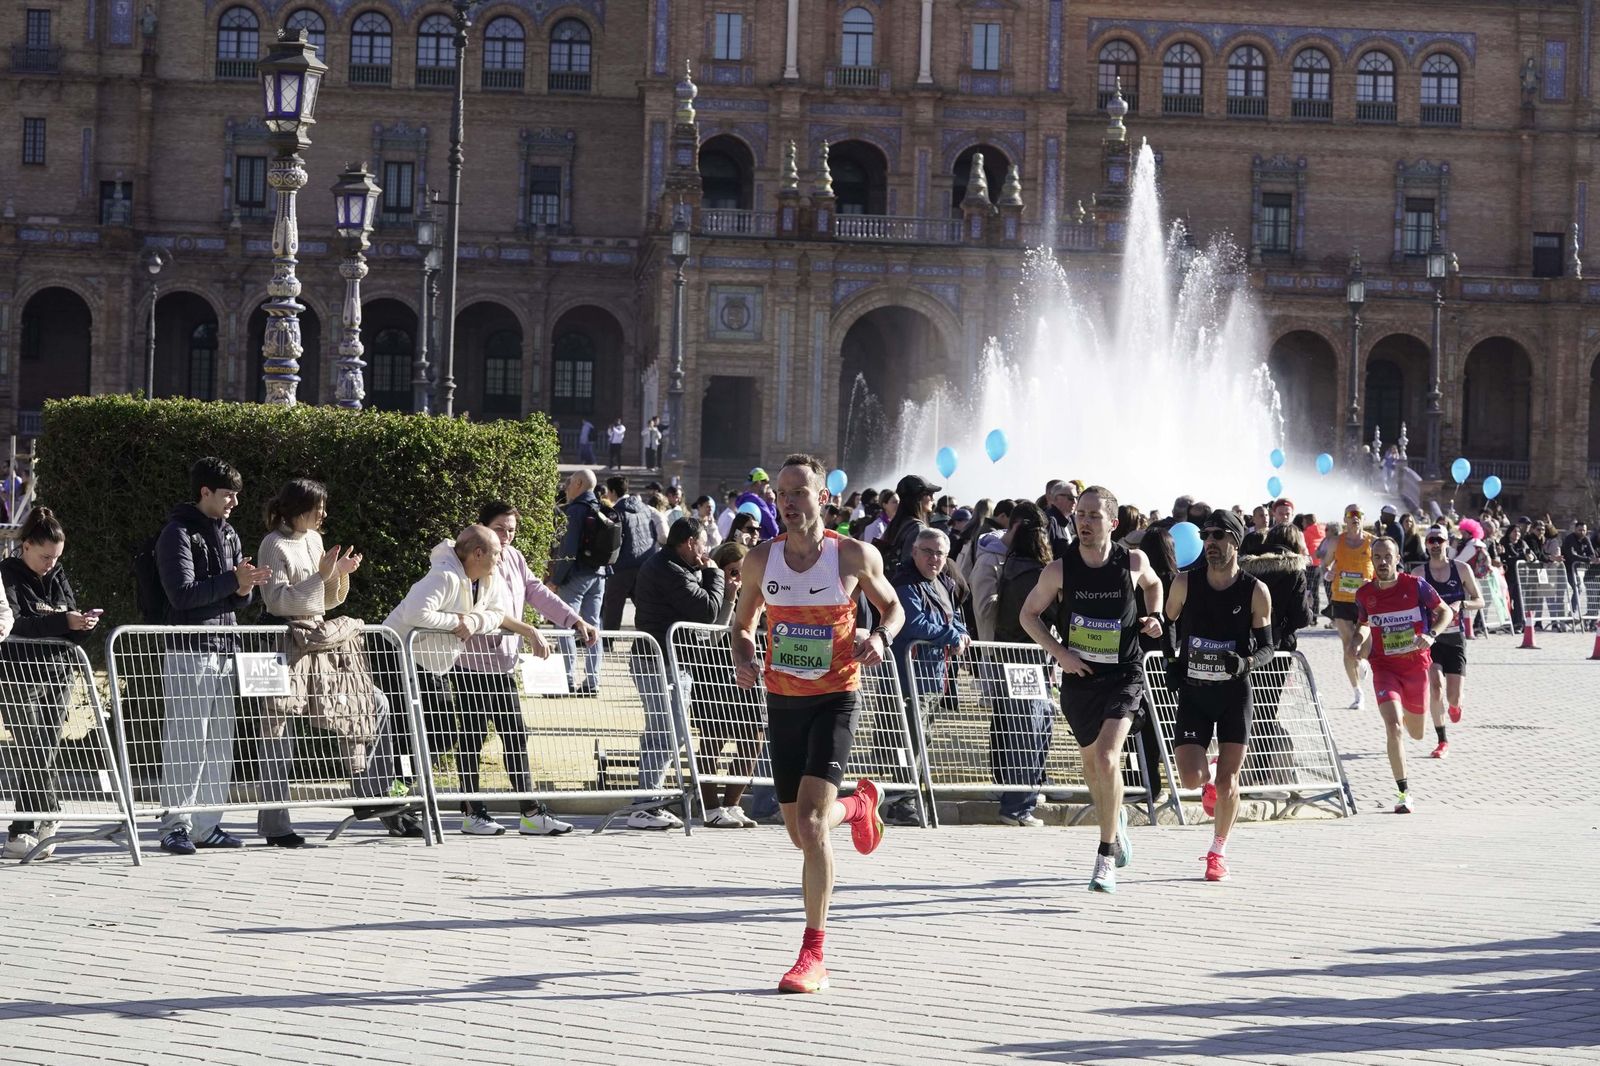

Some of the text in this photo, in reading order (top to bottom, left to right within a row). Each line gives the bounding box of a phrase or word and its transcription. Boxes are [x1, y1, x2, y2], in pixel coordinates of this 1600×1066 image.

[1383, 615, 1413, 624] Avanza
[1087, 620, 1116, 629] ZURICH
[791, 627, 826, 637] ZURICH
[1087, 633, 1102, 641] 1903
[794, 643, 808, 652] 540
[1203, 641, 1230, 649] ZURICH
[780, 652, 823, 668] KRESKA
[250, 659, 278, 677] AMS
[1188, 661, 1213, 672] GILBERT
[1013, 669, 1035, 683] AMS
